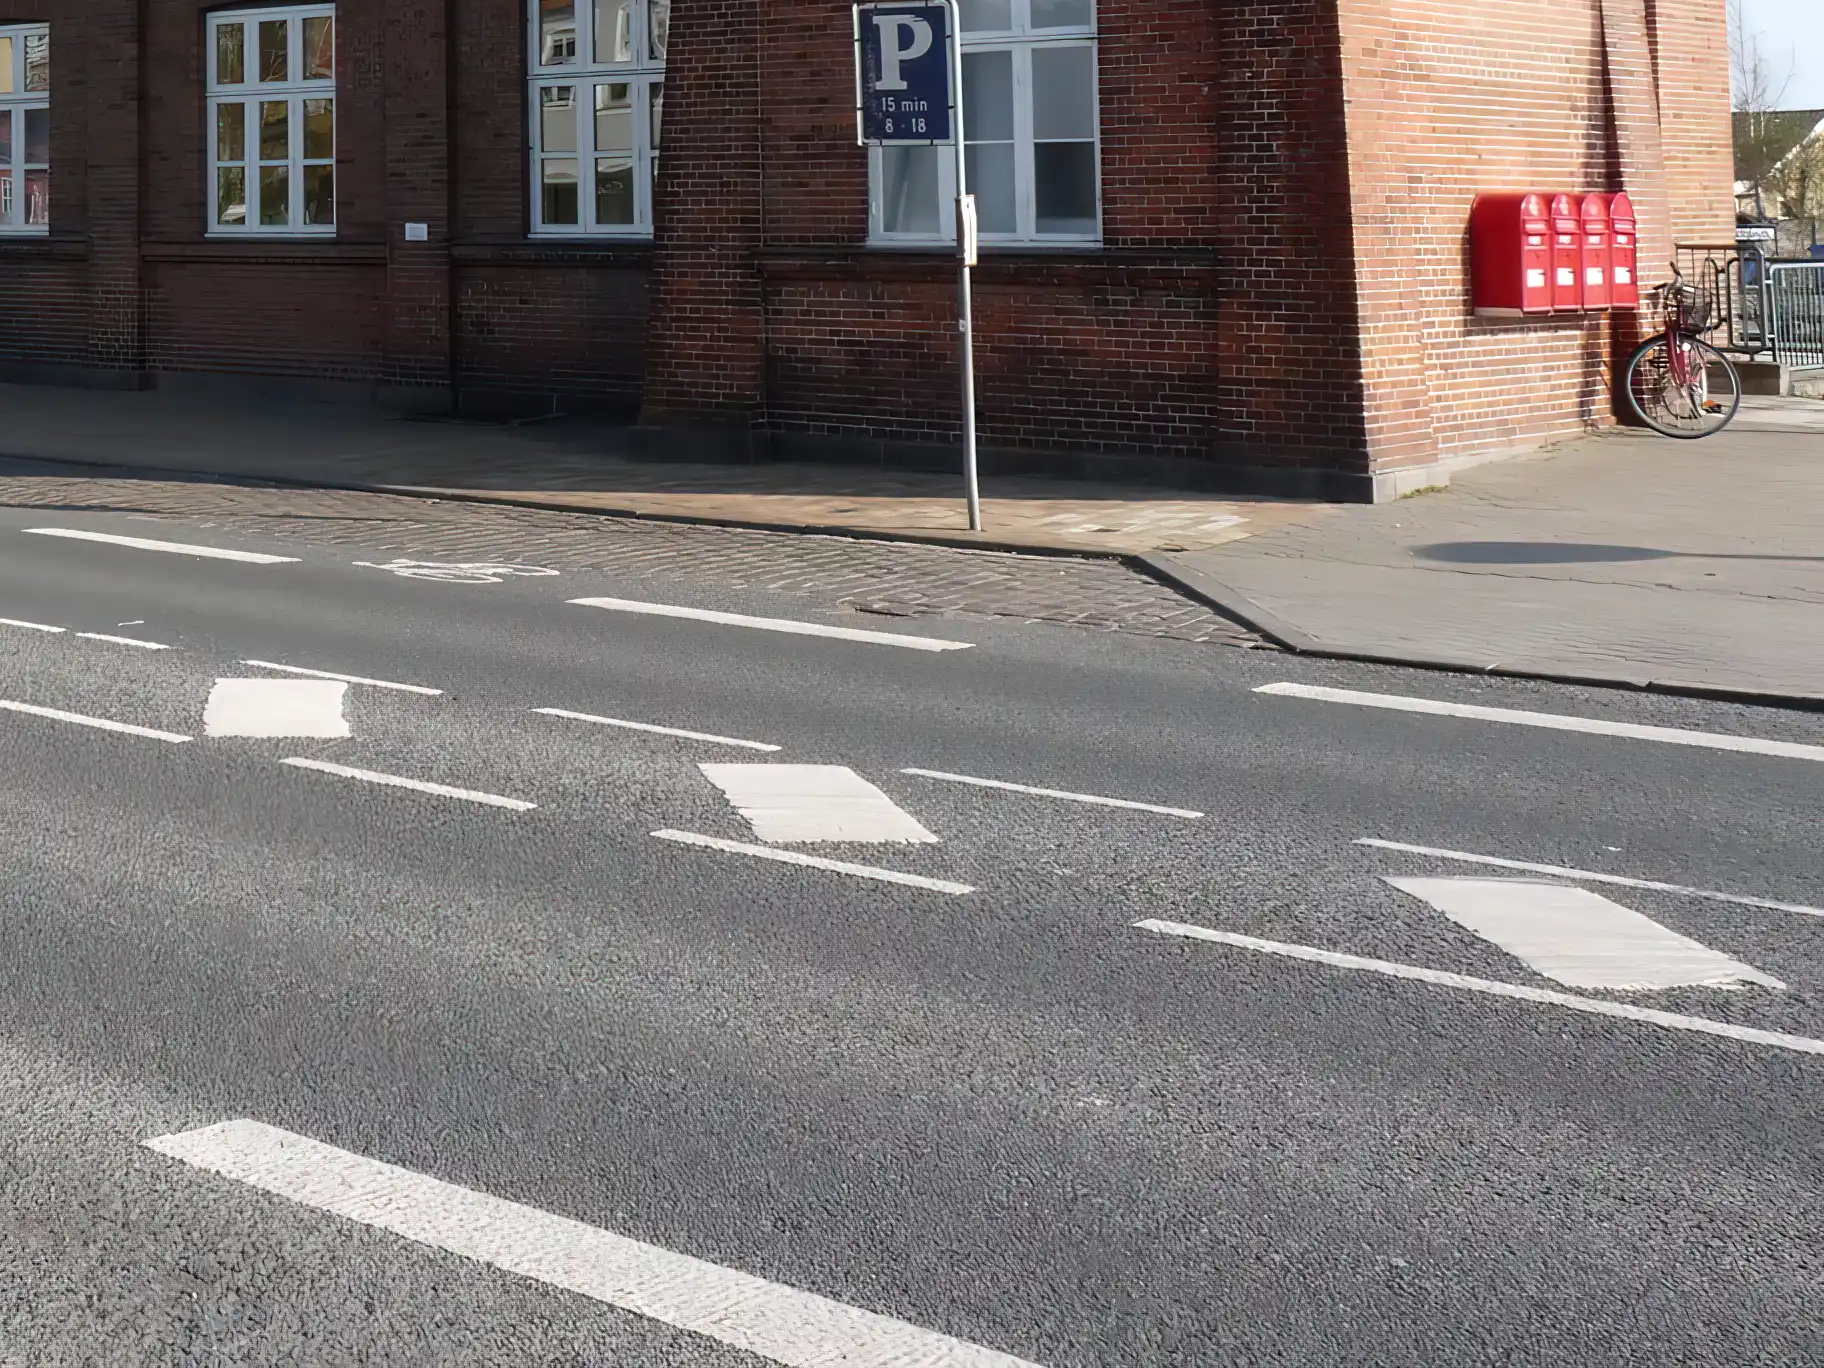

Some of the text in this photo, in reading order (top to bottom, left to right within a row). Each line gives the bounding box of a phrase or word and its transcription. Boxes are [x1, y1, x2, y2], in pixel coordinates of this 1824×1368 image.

[872, 14, 933, 90] P
[881, 97, 928, 112] 15 min
[885, 118, 894, 133] 8
[912, 118, 927, 133] 18
